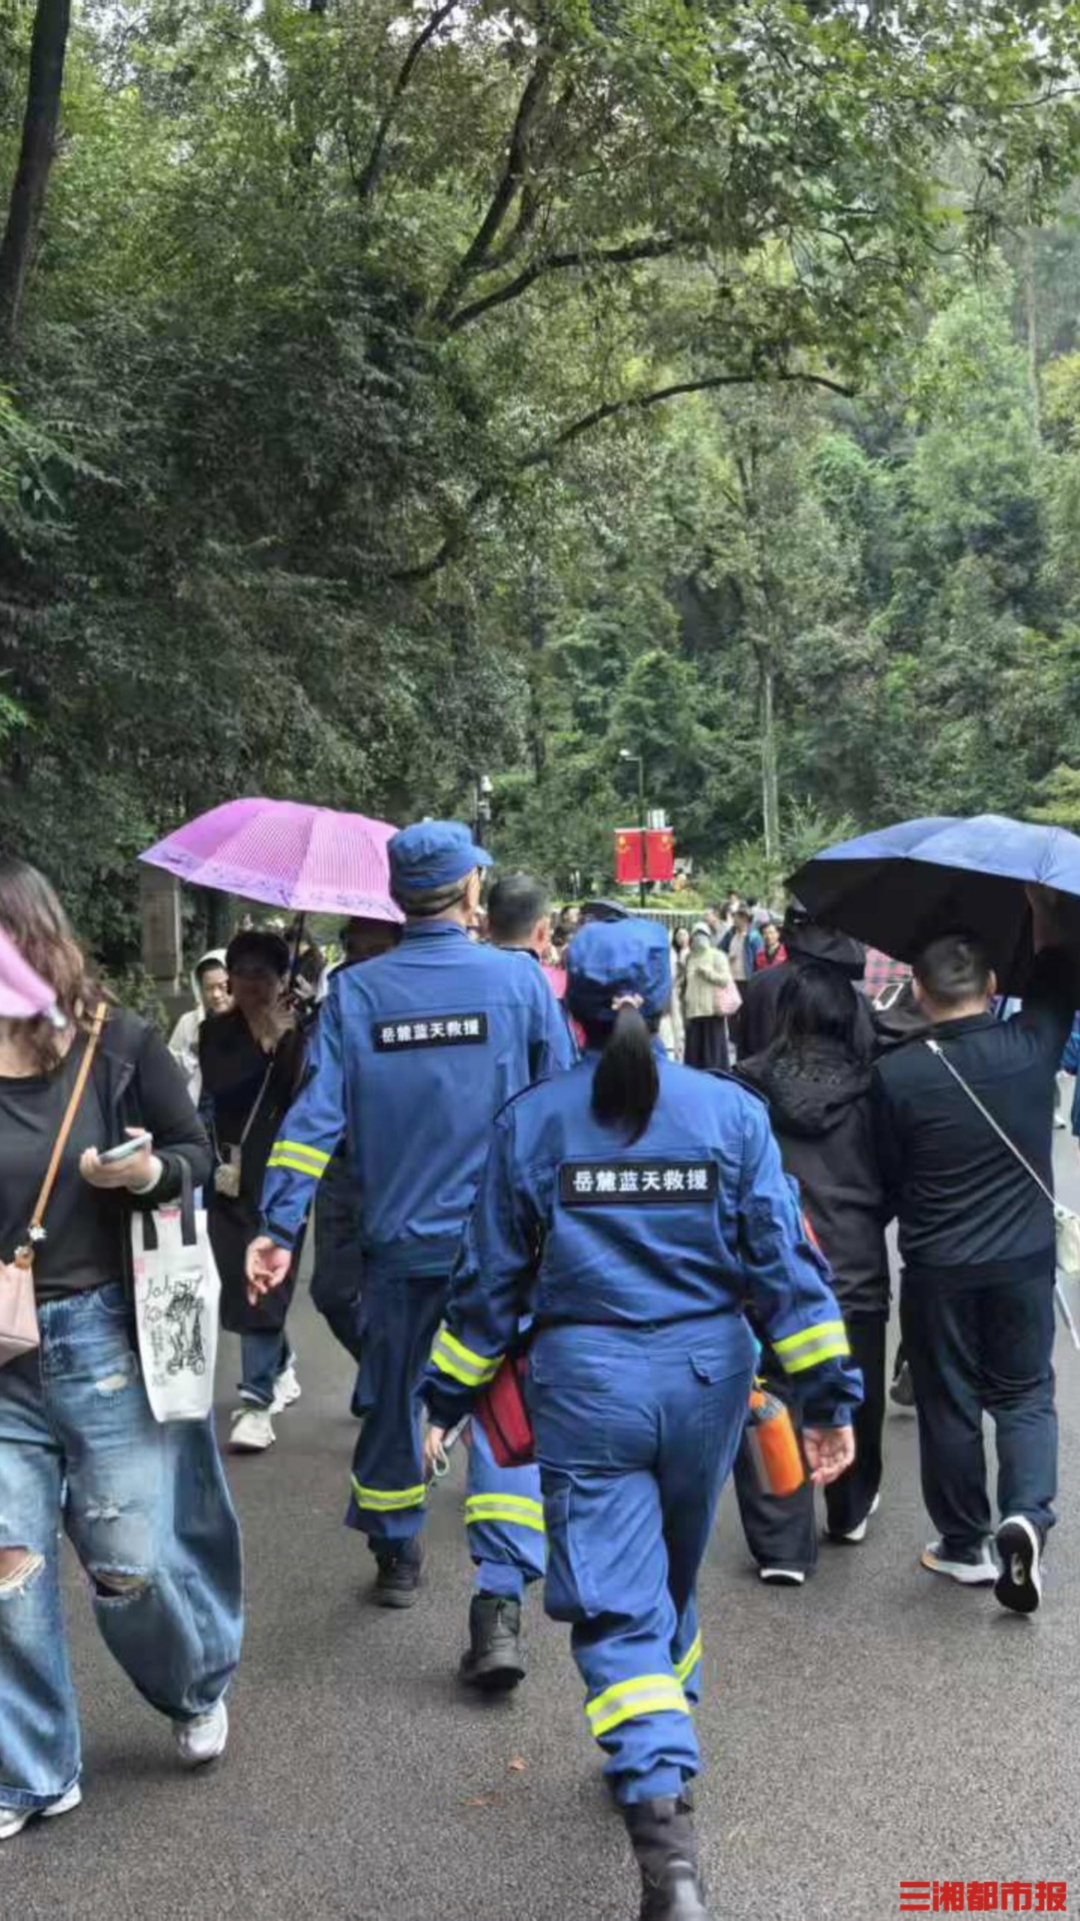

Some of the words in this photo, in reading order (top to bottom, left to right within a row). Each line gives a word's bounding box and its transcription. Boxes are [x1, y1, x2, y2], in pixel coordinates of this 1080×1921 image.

[381, 1019, 479, 1043] 岳麓蓝天救援
[573, 1168, 708, 1192] 岳麓蓝天救援
